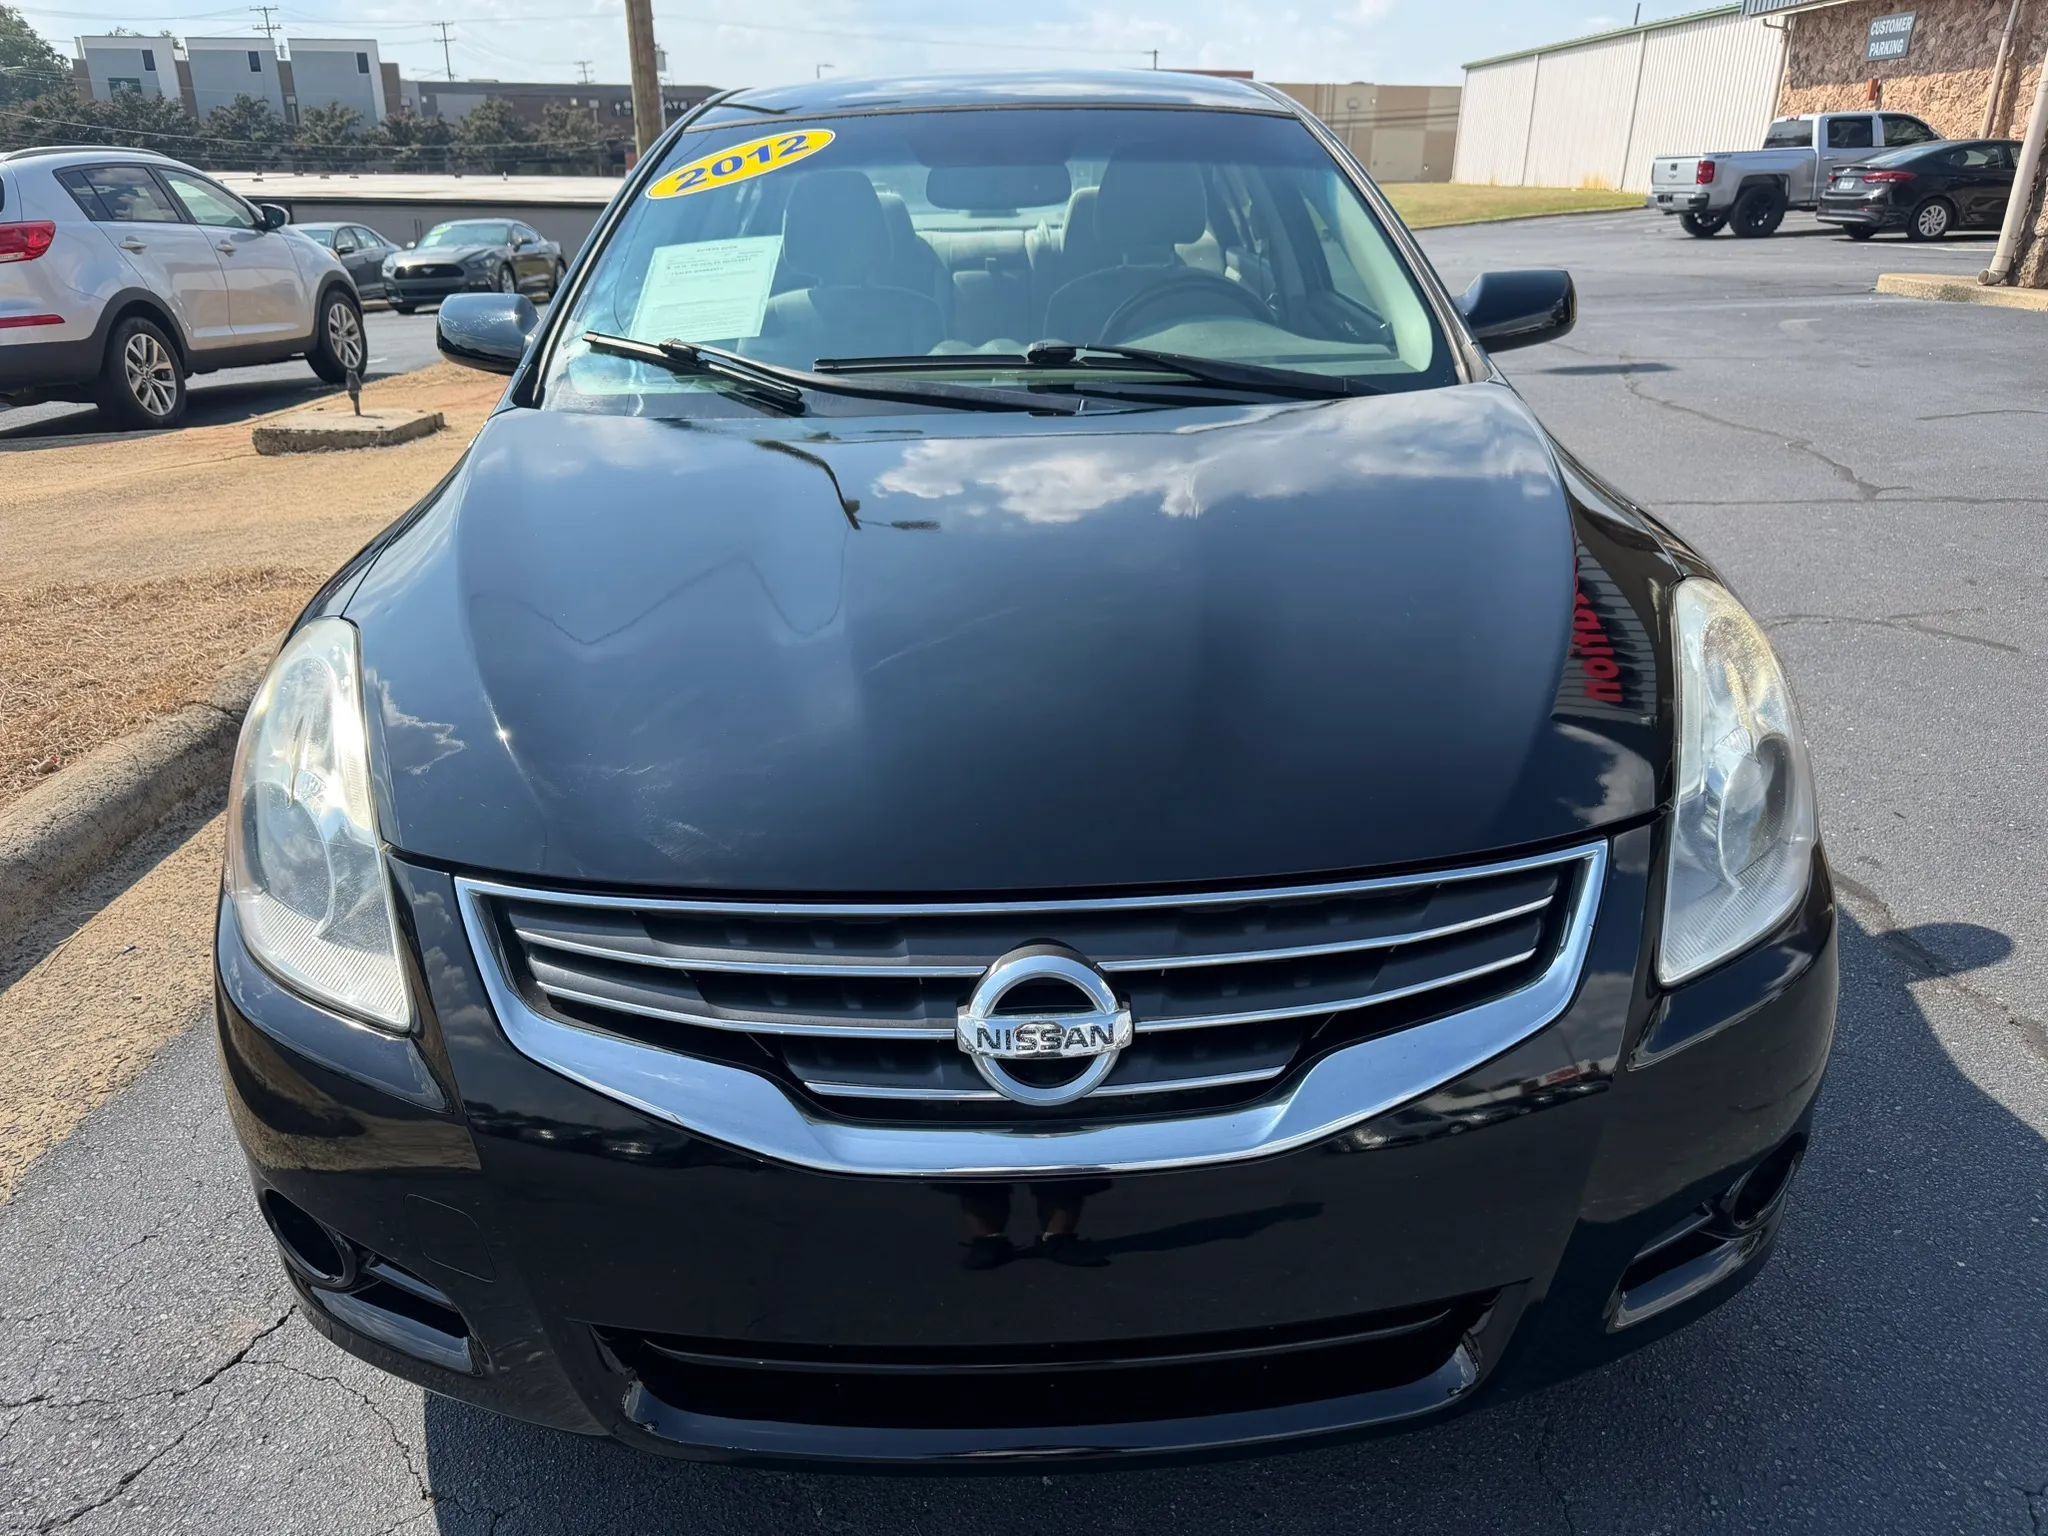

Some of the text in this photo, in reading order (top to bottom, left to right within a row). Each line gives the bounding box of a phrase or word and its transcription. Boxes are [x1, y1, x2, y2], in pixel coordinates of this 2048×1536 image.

[1871, 16, 1913, 36] CUSTOMER
[1868, 39, 1904, 57] PARKING
[675, 135, 810, 193] 2012
[976, 1023, 1115, 1051] NISSAN
